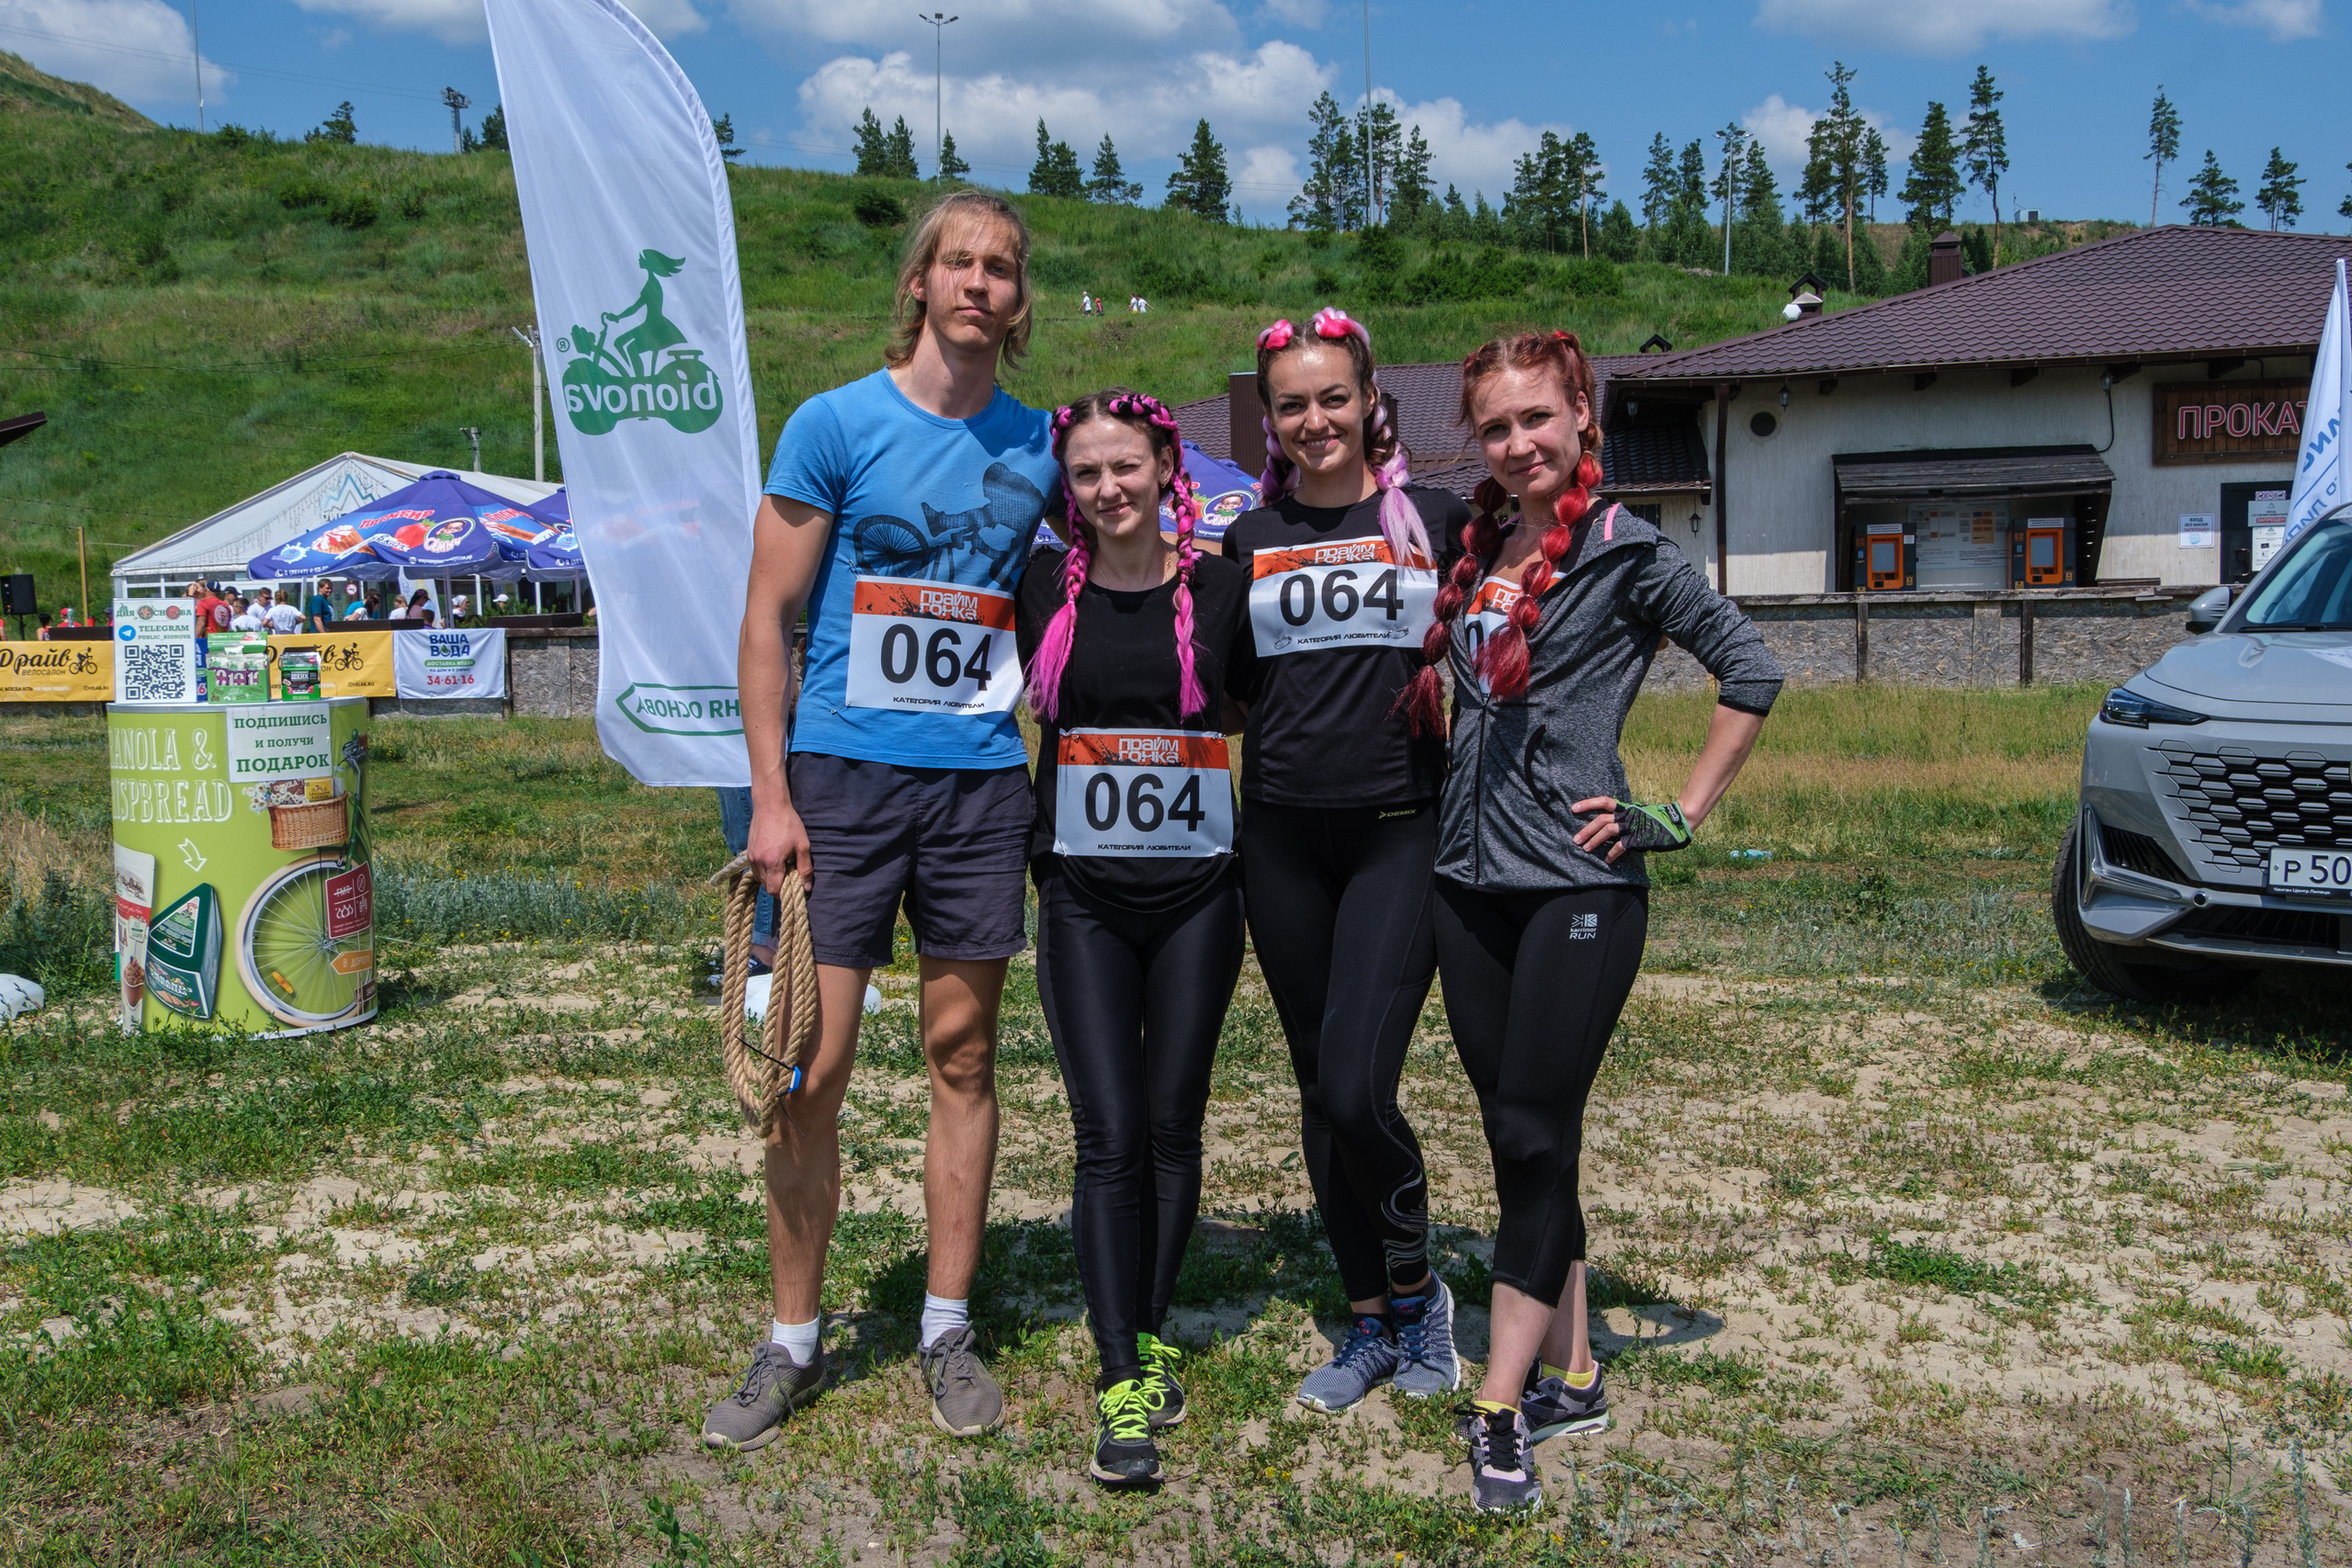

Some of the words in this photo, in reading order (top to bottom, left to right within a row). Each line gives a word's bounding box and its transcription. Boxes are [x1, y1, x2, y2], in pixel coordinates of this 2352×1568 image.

[1280, 569, 1404, 626] 064
[429, 634, 469, 645] ВАША
[1297, 635, 1341, 645] КАТЕГОРИЯ
[430, 645, 470, 658] ВОДА
[881, 623, 992, 691] 064
[893, 696, 941, 705] КАТЕГОРИЯ
[234, 714, 327, 729] ПОДПИШИСЬ
[254, 739, 264, 748] И
[267, 737, 314, 747] ПОЛУЧИ
[236, 753, 330, 773] ПОДАРОК
[1085, 773, 1205, 832] 064
